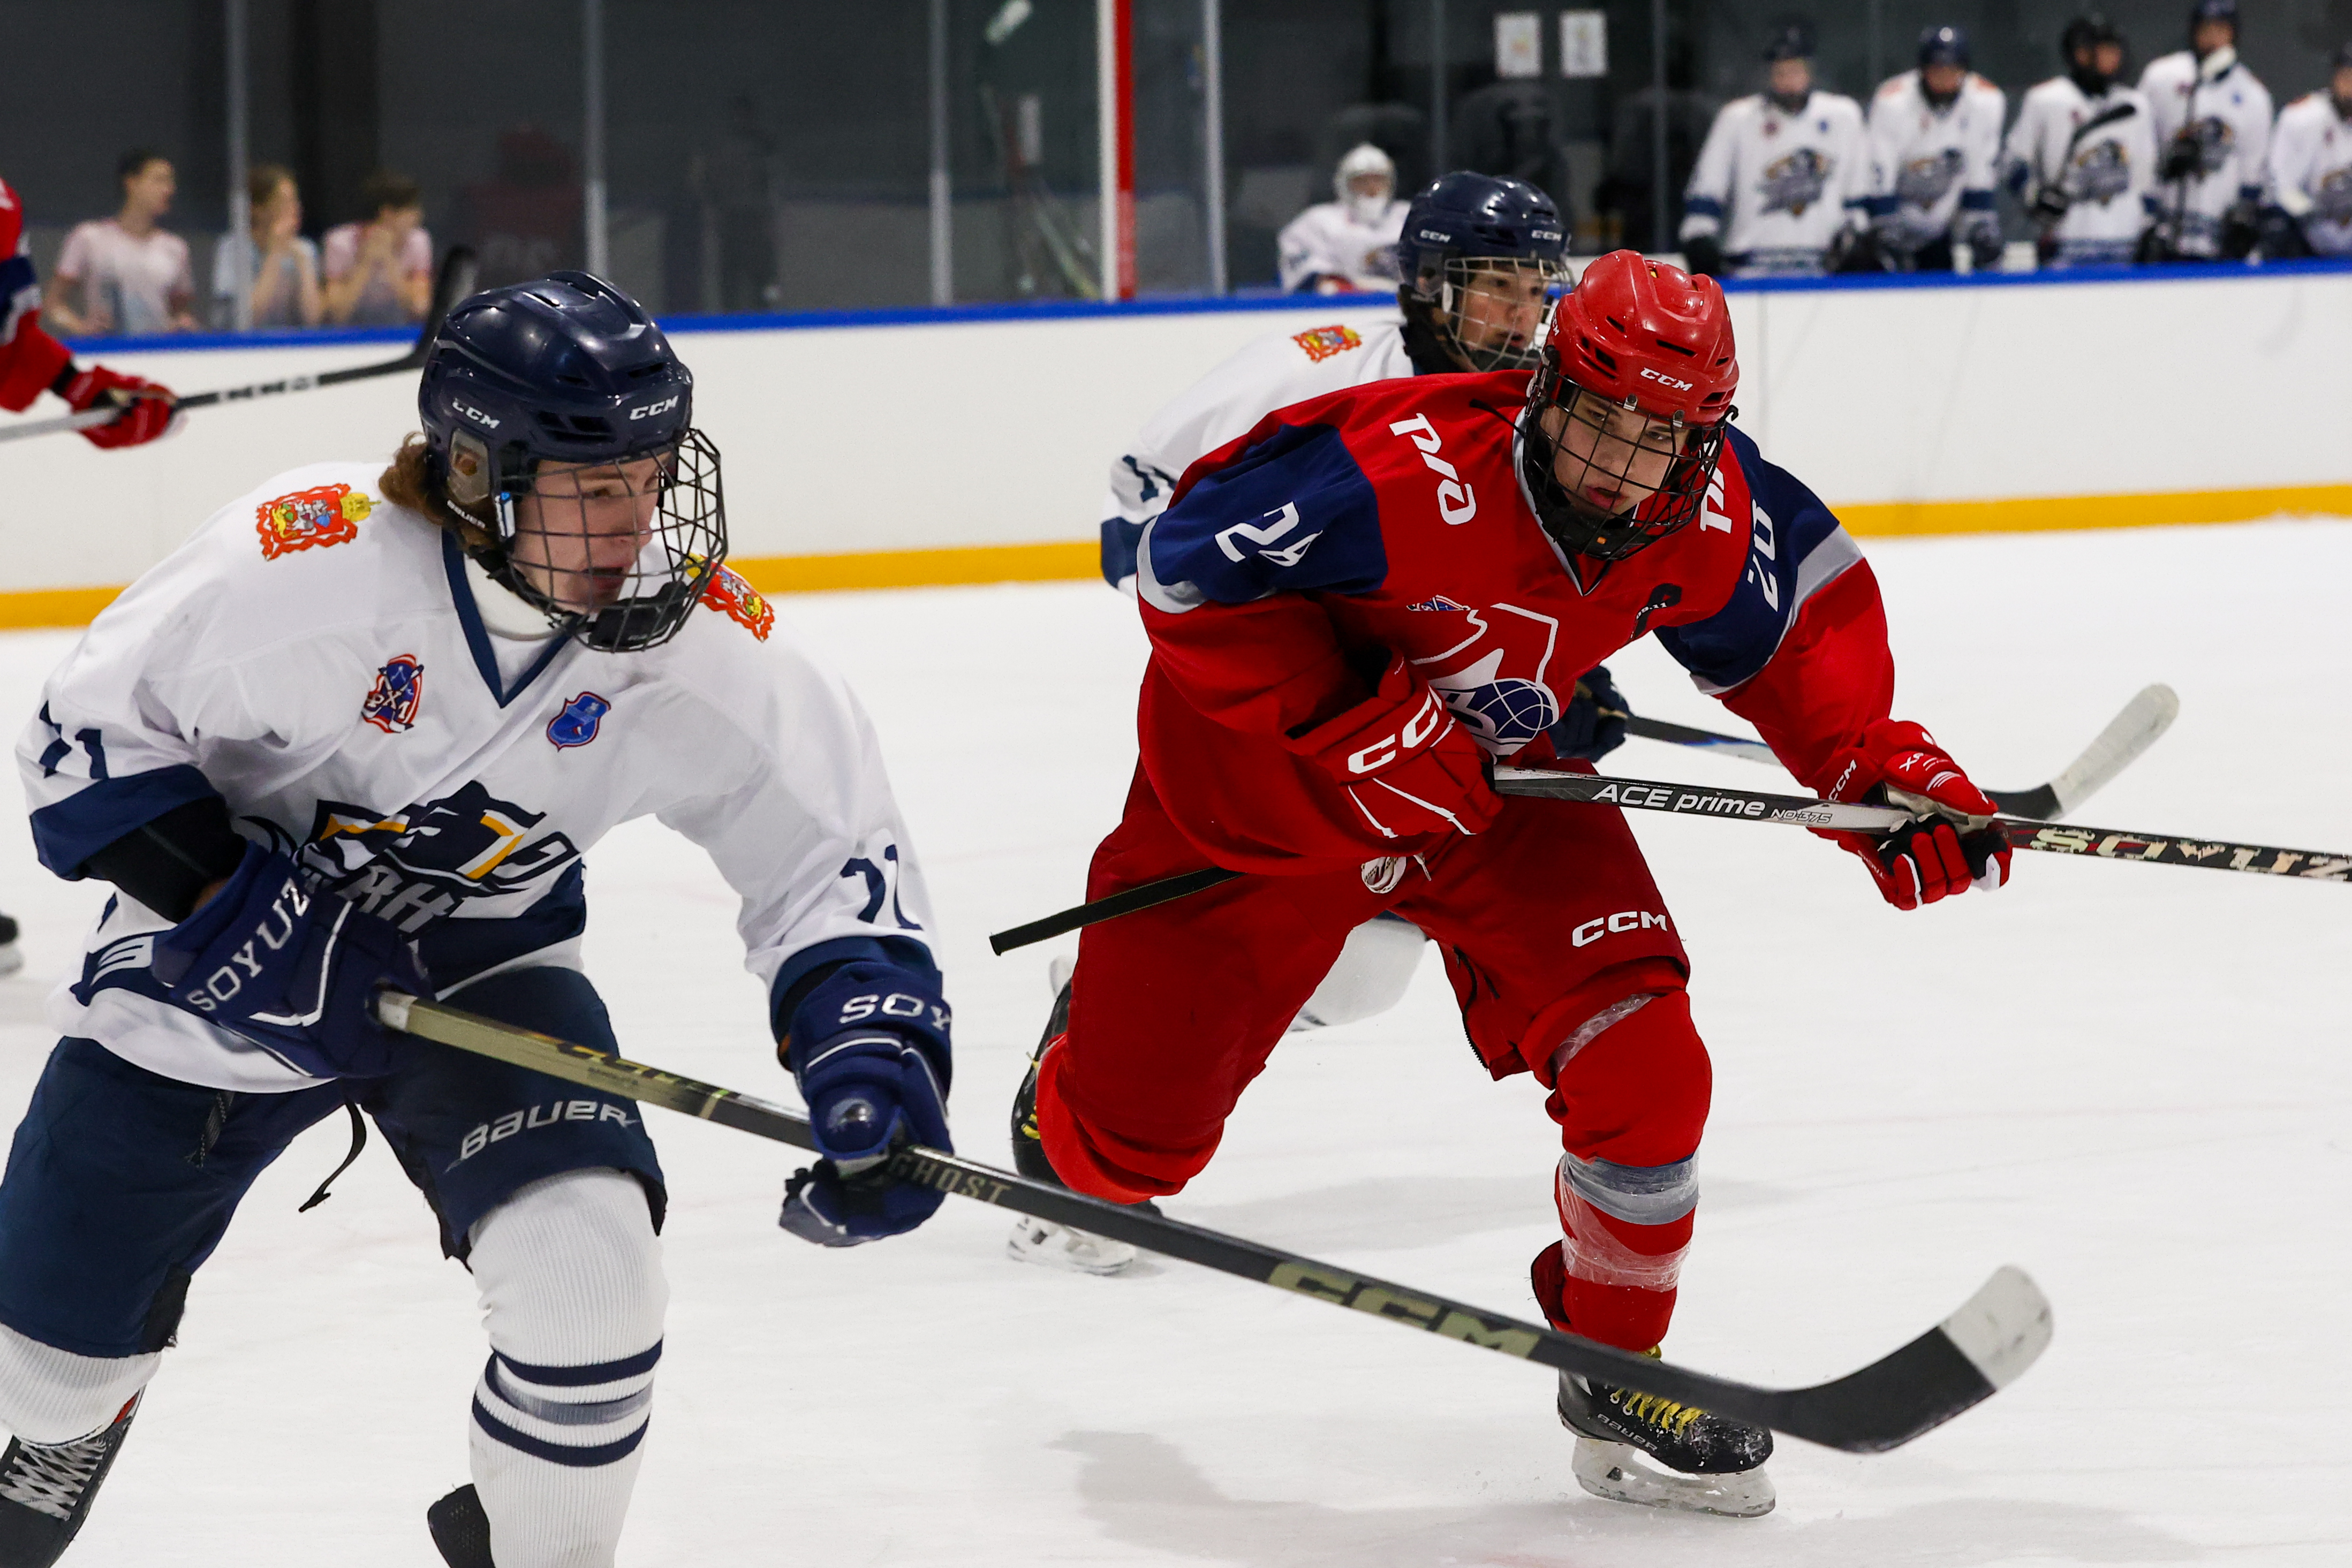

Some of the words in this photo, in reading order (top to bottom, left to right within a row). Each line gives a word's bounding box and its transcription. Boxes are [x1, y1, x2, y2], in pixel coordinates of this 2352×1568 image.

[1640, 367, 1693, 391] CCM
[452, 398, 501, 428] CCM
[629, 395, 679, 420] CCM
[1591, 783, 1673, 807] ACE
[1673, 791, 1766, 817] prime
[186, 876, 311, 1012] SOYUZ
[1572, 911, 1668, 948] CCM
[1267, 1262, 1541, 1360] CCM
